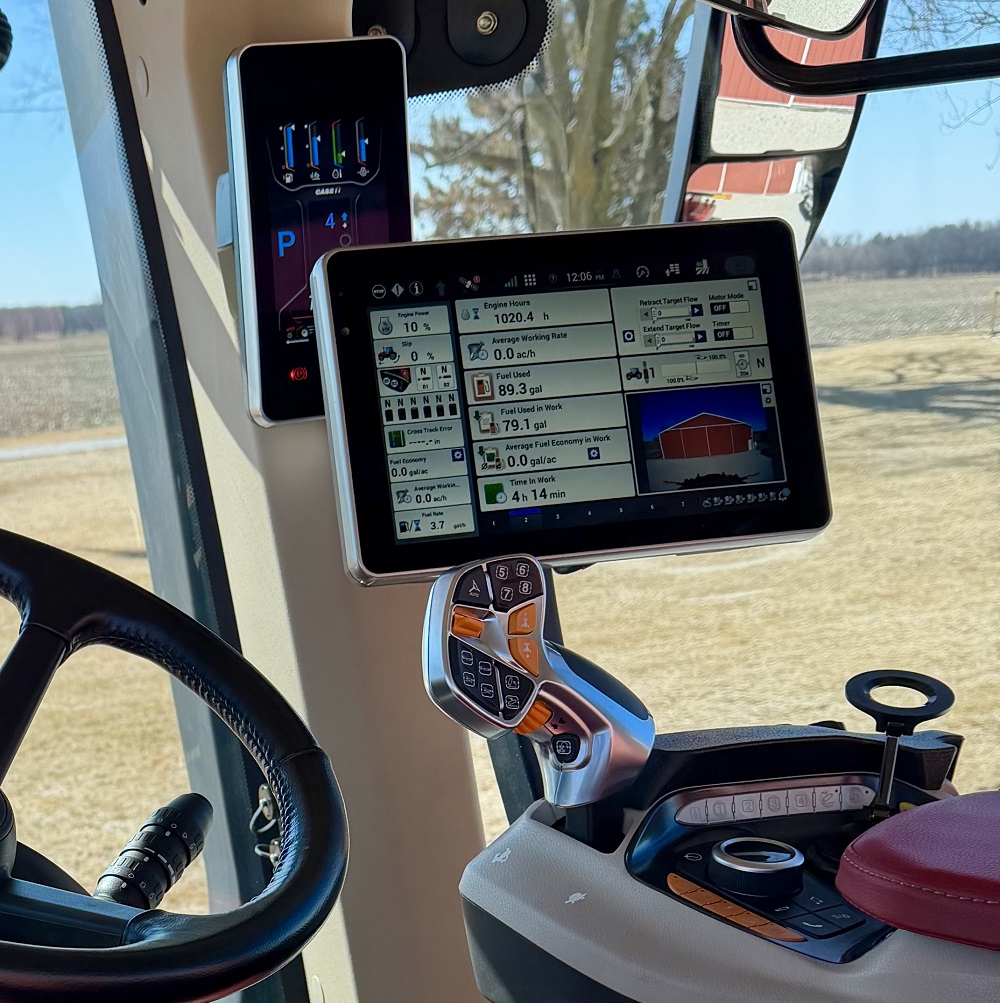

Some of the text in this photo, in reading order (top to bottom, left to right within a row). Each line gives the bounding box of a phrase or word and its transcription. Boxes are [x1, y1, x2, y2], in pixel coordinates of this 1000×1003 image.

[315, 187, 334, 195] CASE
[325, 212, 336, 229] 4
[277, 230, 296, 258] P
[566, 271, 593, 282] 12:06
[483, 302, 508, 310] Engine
[662, 297, 683, 305] Target
[494, 311, 549, 324] 1020.4 h
[403, 321, 431, 333] 10 %
[665, 323, 685, 331] Target
[492, 336, 520, 345] Average
[521, 333, 550, 342] Working
[411, 351, 435, 362] 0 %
[494, 347, 536, 360] 0.0 ac/h
[756, 358, 765, 368] N
[420, 365, 447, 375] N N
[496, 370, 531, 380] Fuel Used
[498, 382, 543, 396] 89.3 gal
[385, 394, 454, 408] N N N N N N
[501, 407, 516, 415] Fuel
[518, 405, 535, 414] Used
[545, 403, 563, 411] Work
[502, 418, 547, 432] 79.1 gal
[505, 443, 534, 451] Average
[535, 440, 550, 448] Fuel
[552, 437, 584, 447] Economy
[507, 454, 557, 467] 0.0 gal/ac
[391, 467, 428, 477] 0.0 gal/ac
[537, 476, 556, 484] Work
[415, 494, 432, 503] 0.0
[511, 488, 566, 502] 4 h 14 min
[430, 521, 444, 530] 3.7
[498, 565, 526, 578] 5 6
[504, 583, 528, 599] 7 8
